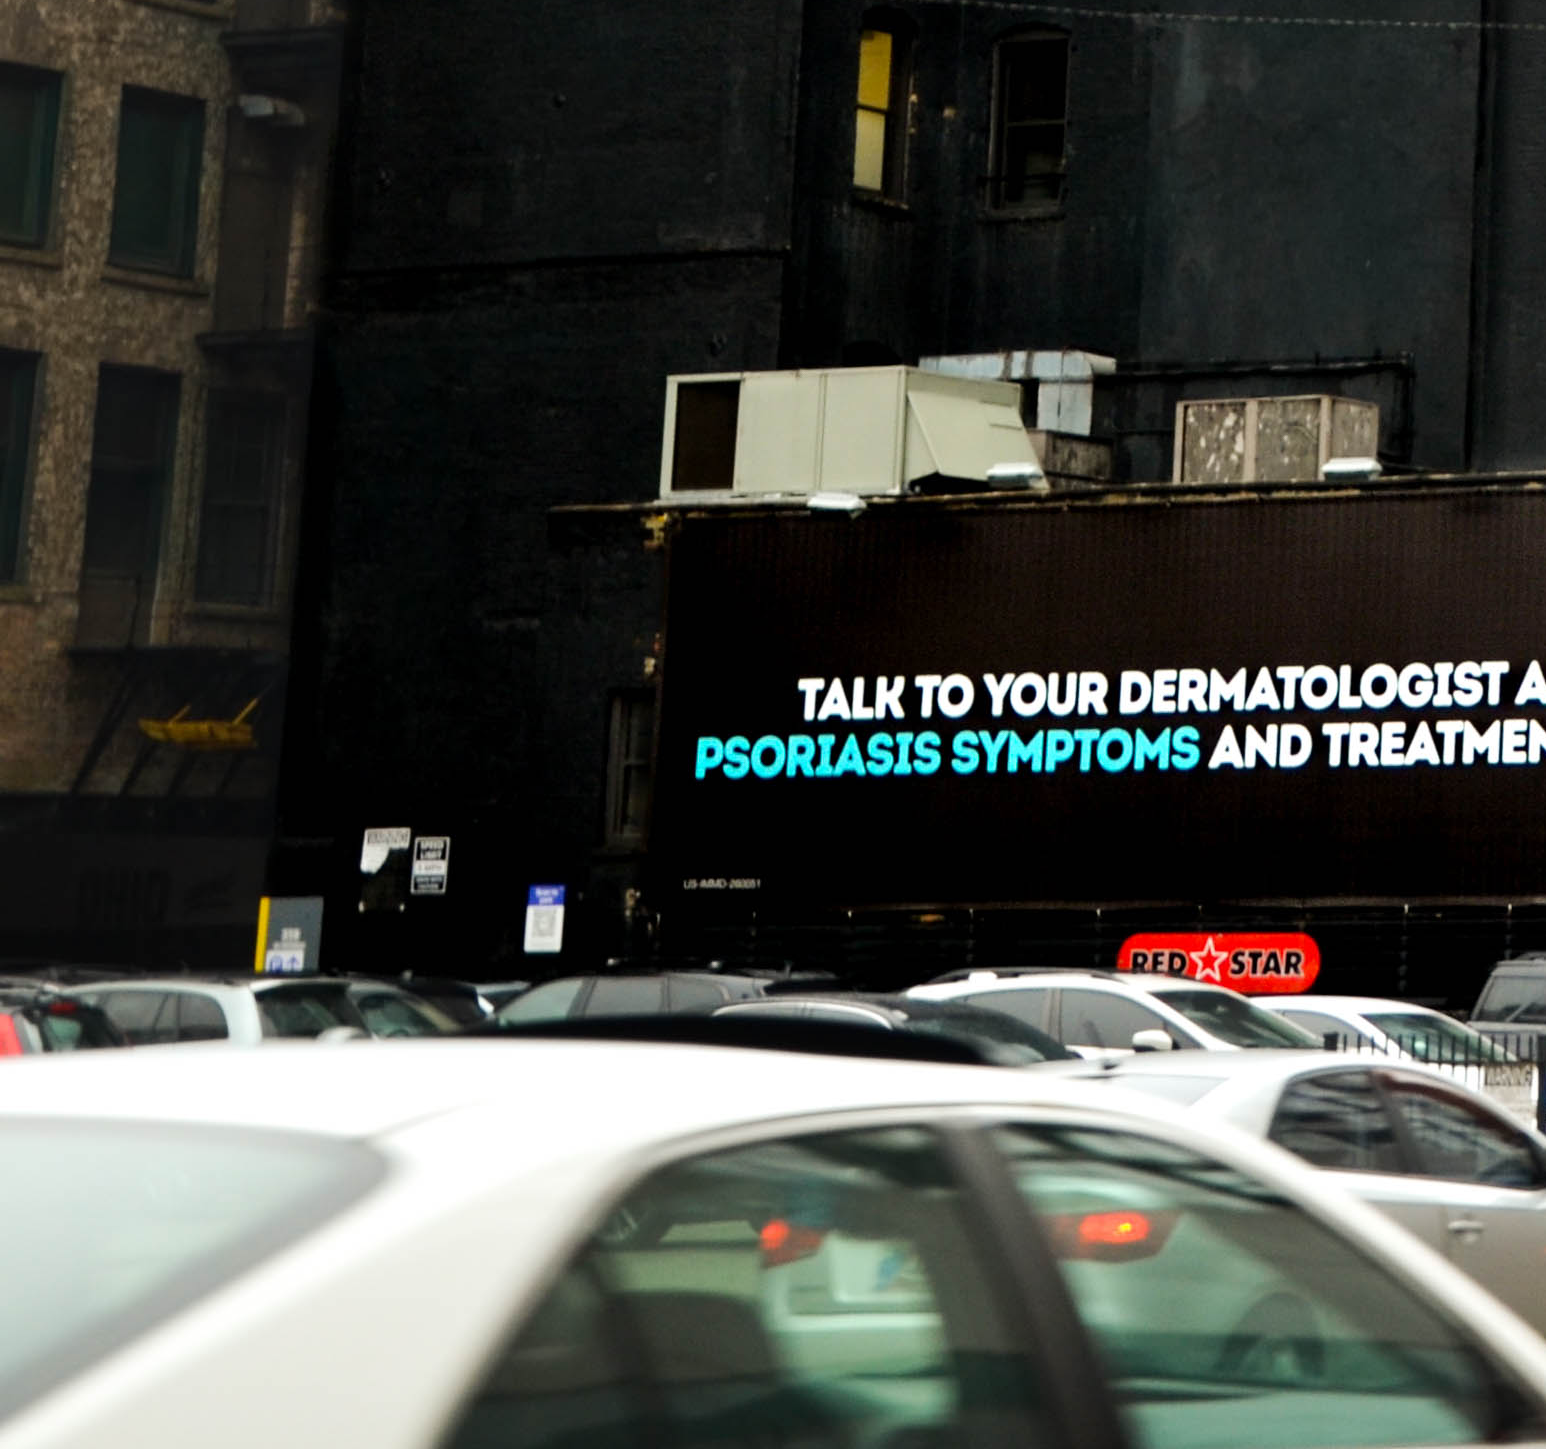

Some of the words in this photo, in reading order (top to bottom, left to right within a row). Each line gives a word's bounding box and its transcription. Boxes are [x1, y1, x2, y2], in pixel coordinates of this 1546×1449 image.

[797, 675, 906, 721] TALK
[914, 673, 975, 719] TO
[982, 670, 1108, 717] YOUR
[1117, 660, 1510, 715] DERMATOLOGIST
[694, 730, 943, 780] PSORIASIS
[950, 725, 1202, 774] SYMPTOMS
[1207, 723, 1313, 770] AND
[1131, 952, 1187, 975] RED
[1231, 951, 1303, 976] STAR
